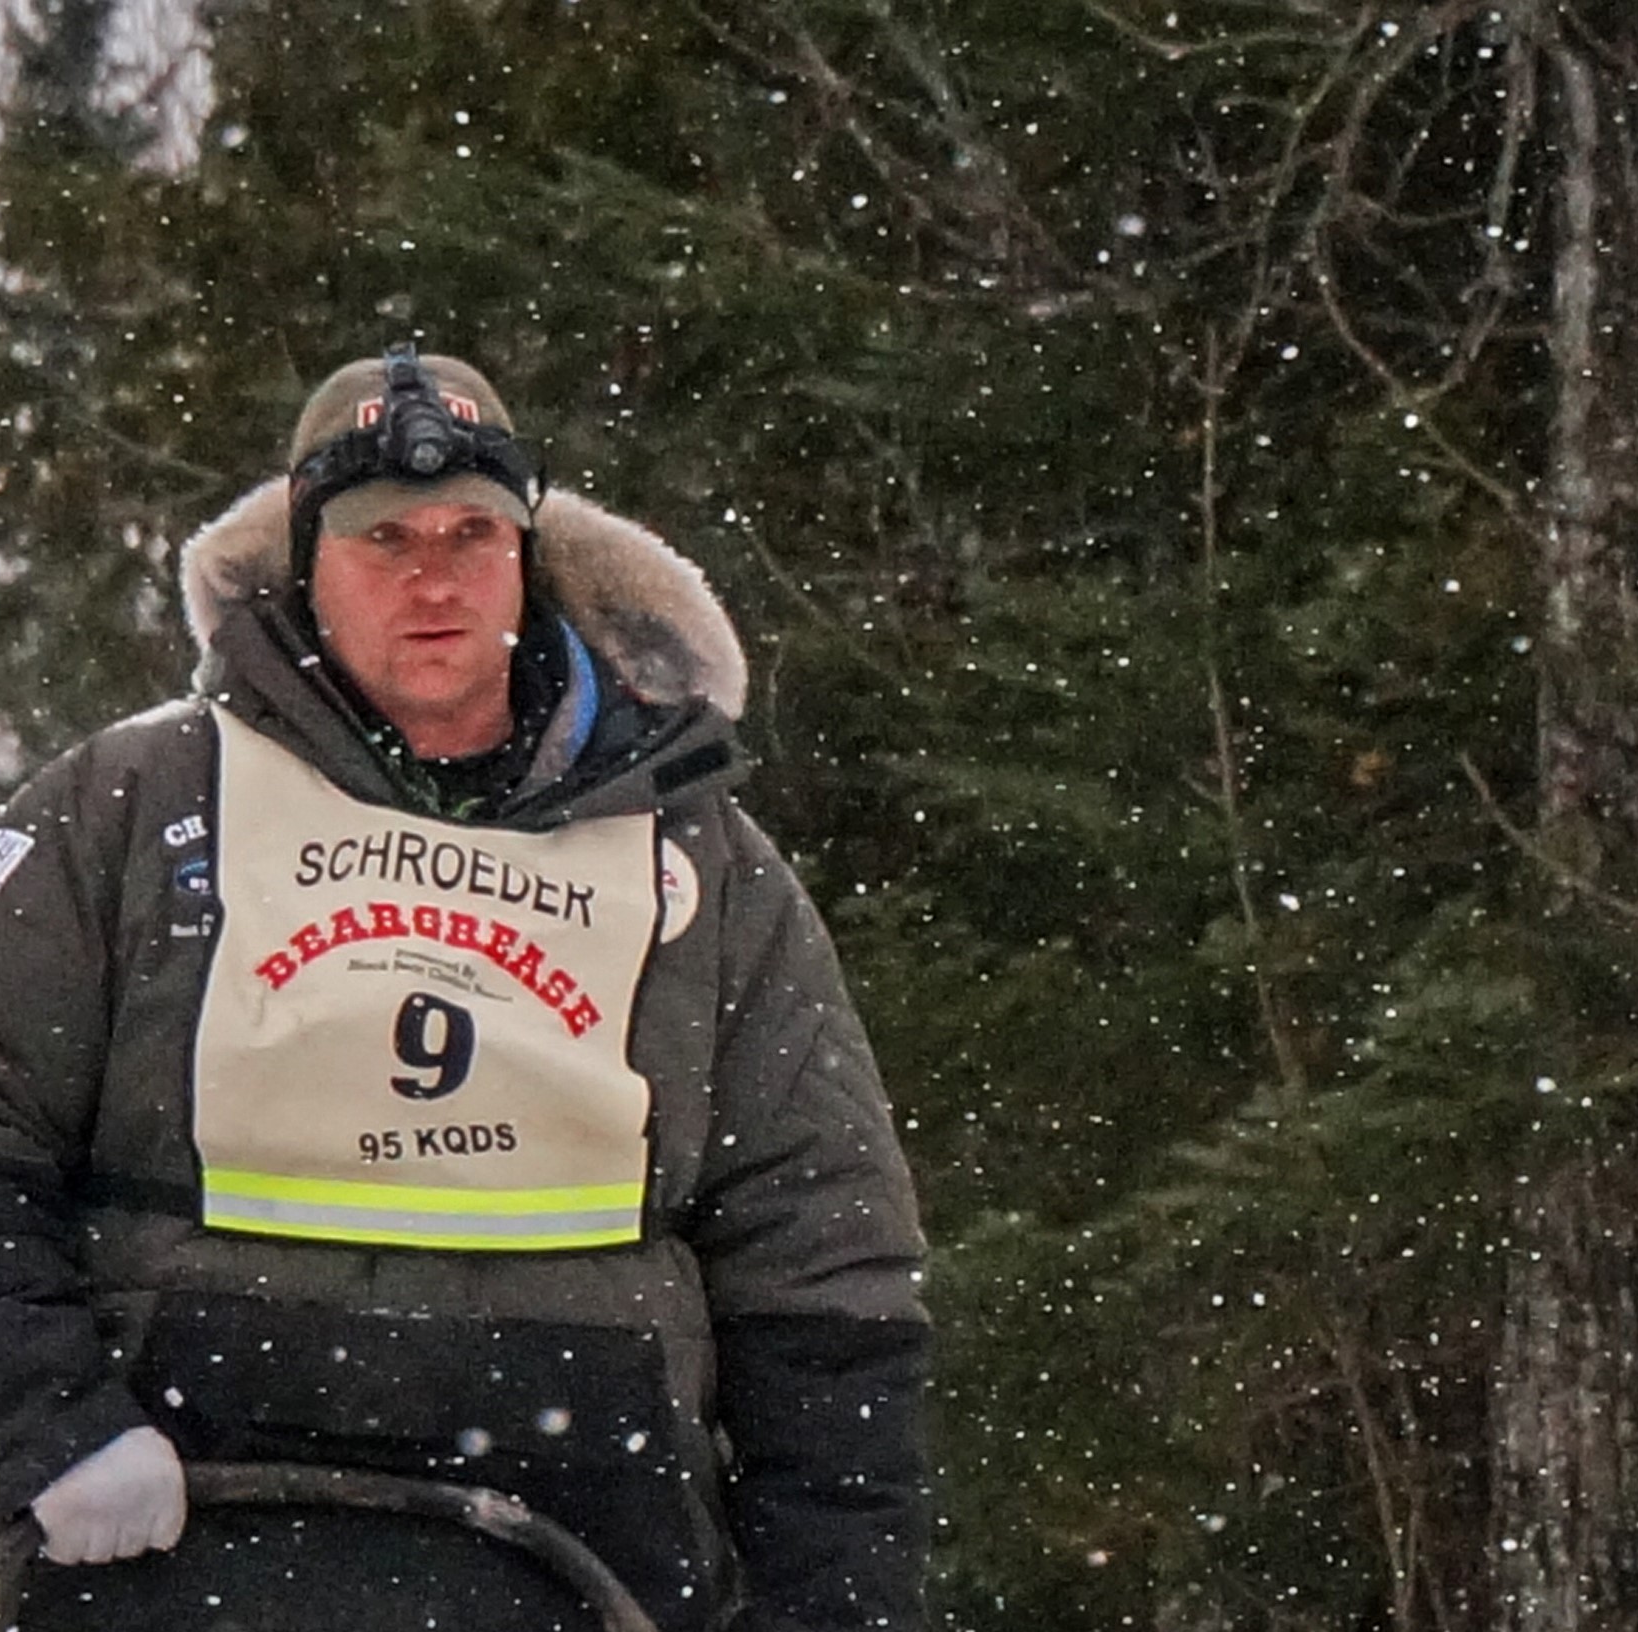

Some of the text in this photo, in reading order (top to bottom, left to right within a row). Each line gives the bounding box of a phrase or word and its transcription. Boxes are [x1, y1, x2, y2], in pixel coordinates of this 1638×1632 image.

[295, 830, 595, 928] SCHROEDER
[255, 902, 603, 1038] BEARGREASE
[390, 991, 475, 1101] 9
[358, 1123, 517, 1162] 95 KQDS
